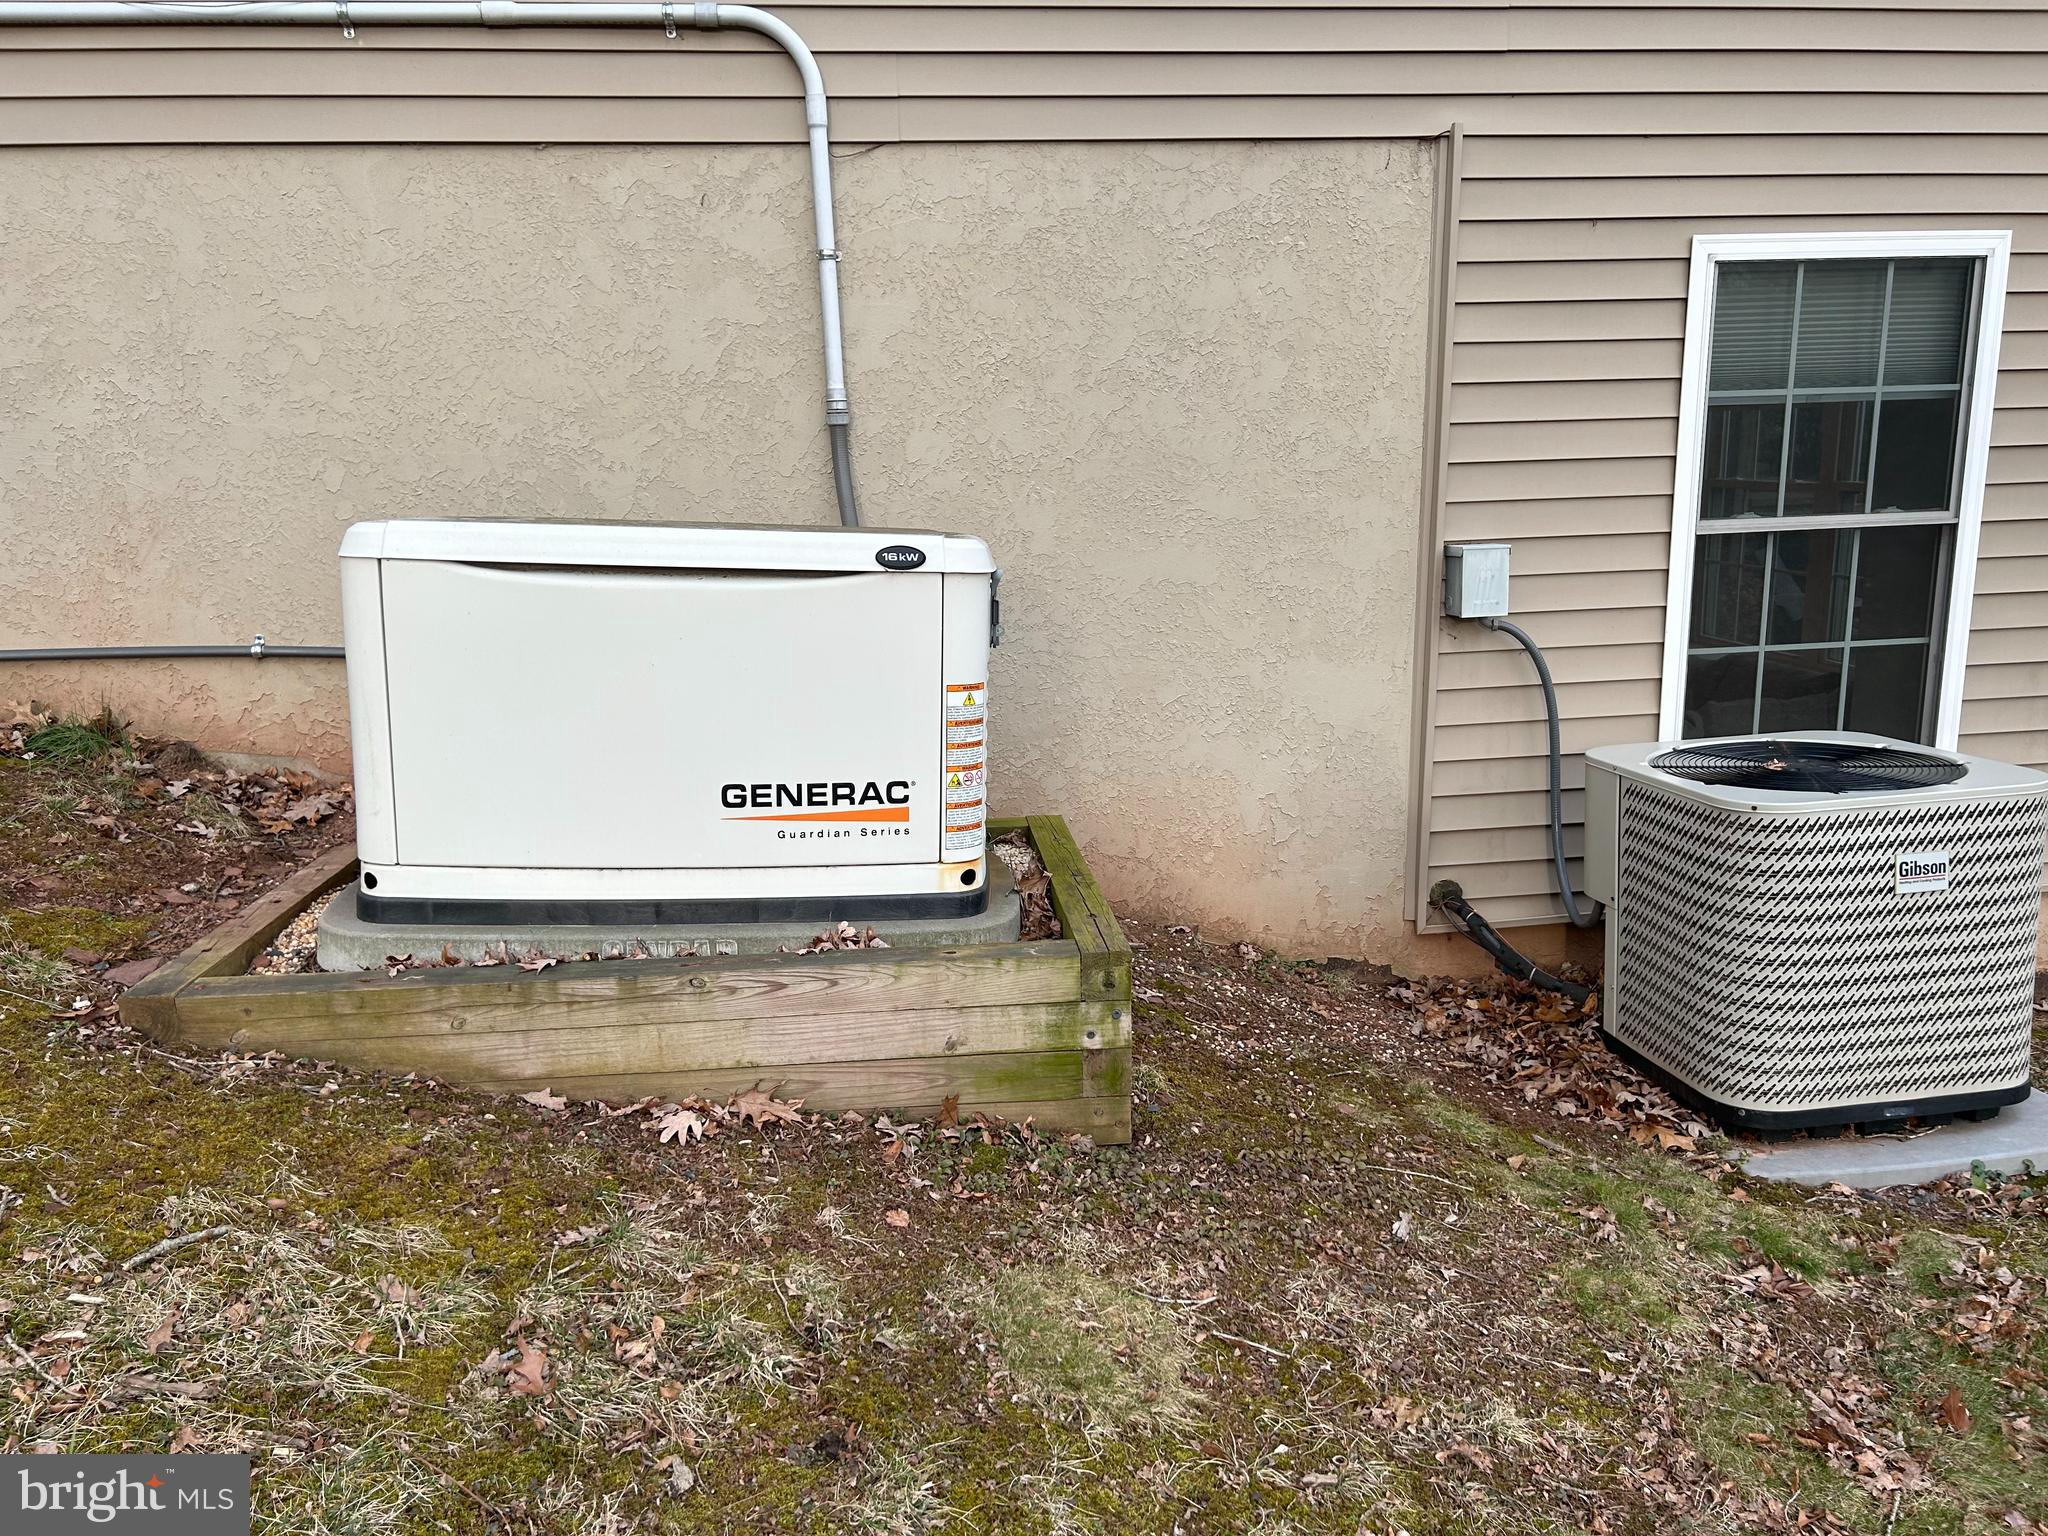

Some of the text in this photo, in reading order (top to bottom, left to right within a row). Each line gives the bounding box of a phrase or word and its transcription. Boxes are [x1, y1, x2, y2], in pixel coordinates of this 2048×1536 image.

[777, 827, 910, 839] Guardian Series
[1899, 861, 1946, 877] Gibson
